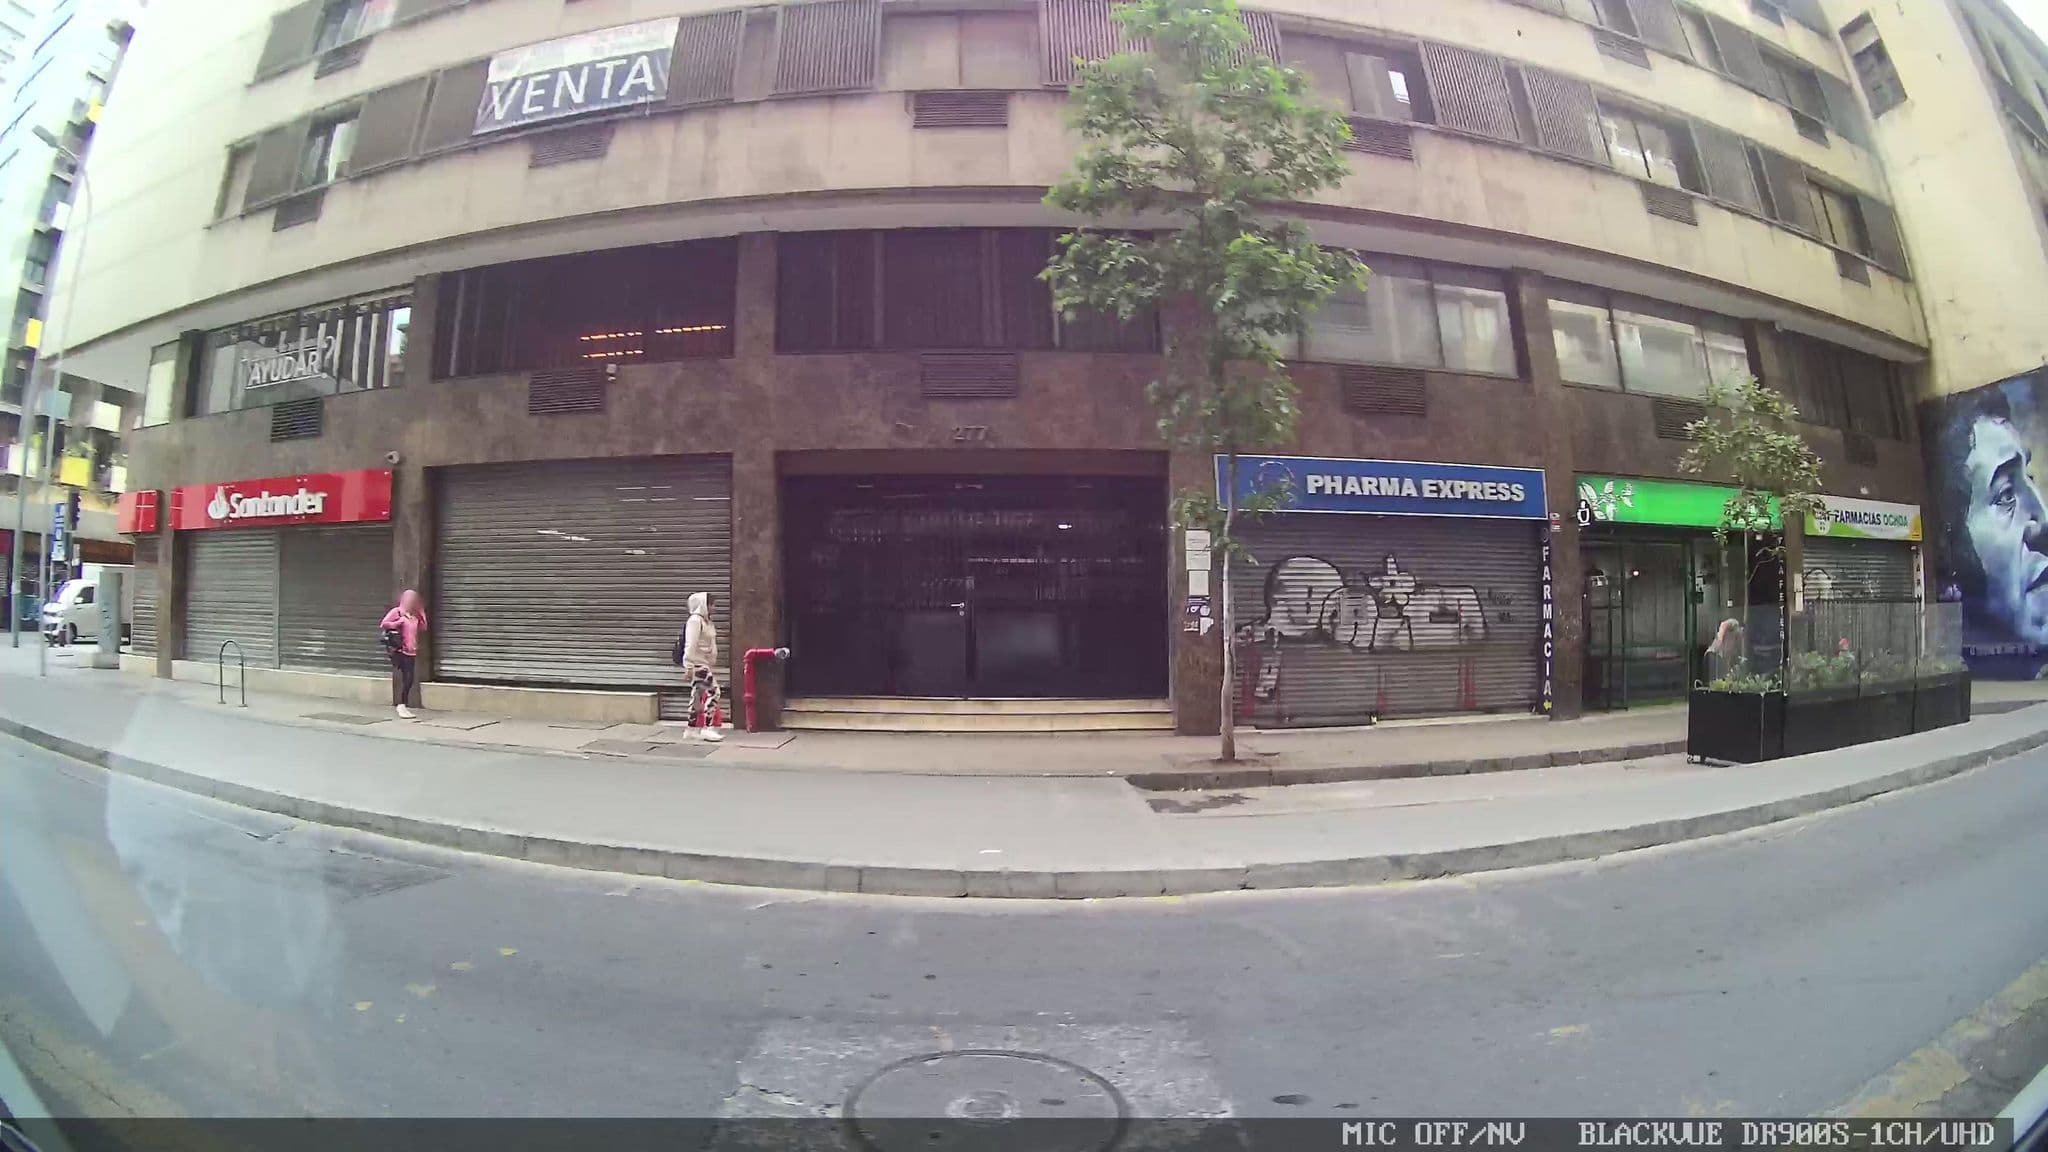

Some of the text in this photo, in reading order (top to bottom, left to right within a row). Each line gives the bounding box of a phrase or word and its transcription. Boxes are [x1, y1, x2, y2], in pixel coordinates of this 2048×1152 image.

[493, 55, 655, 121] VENTA
[229, 488, 328, 519] Santander
[1306, 474, 1526, 502] PHARMA EXPRESS
[1541, 546, 1552, 696] FARMACIA
